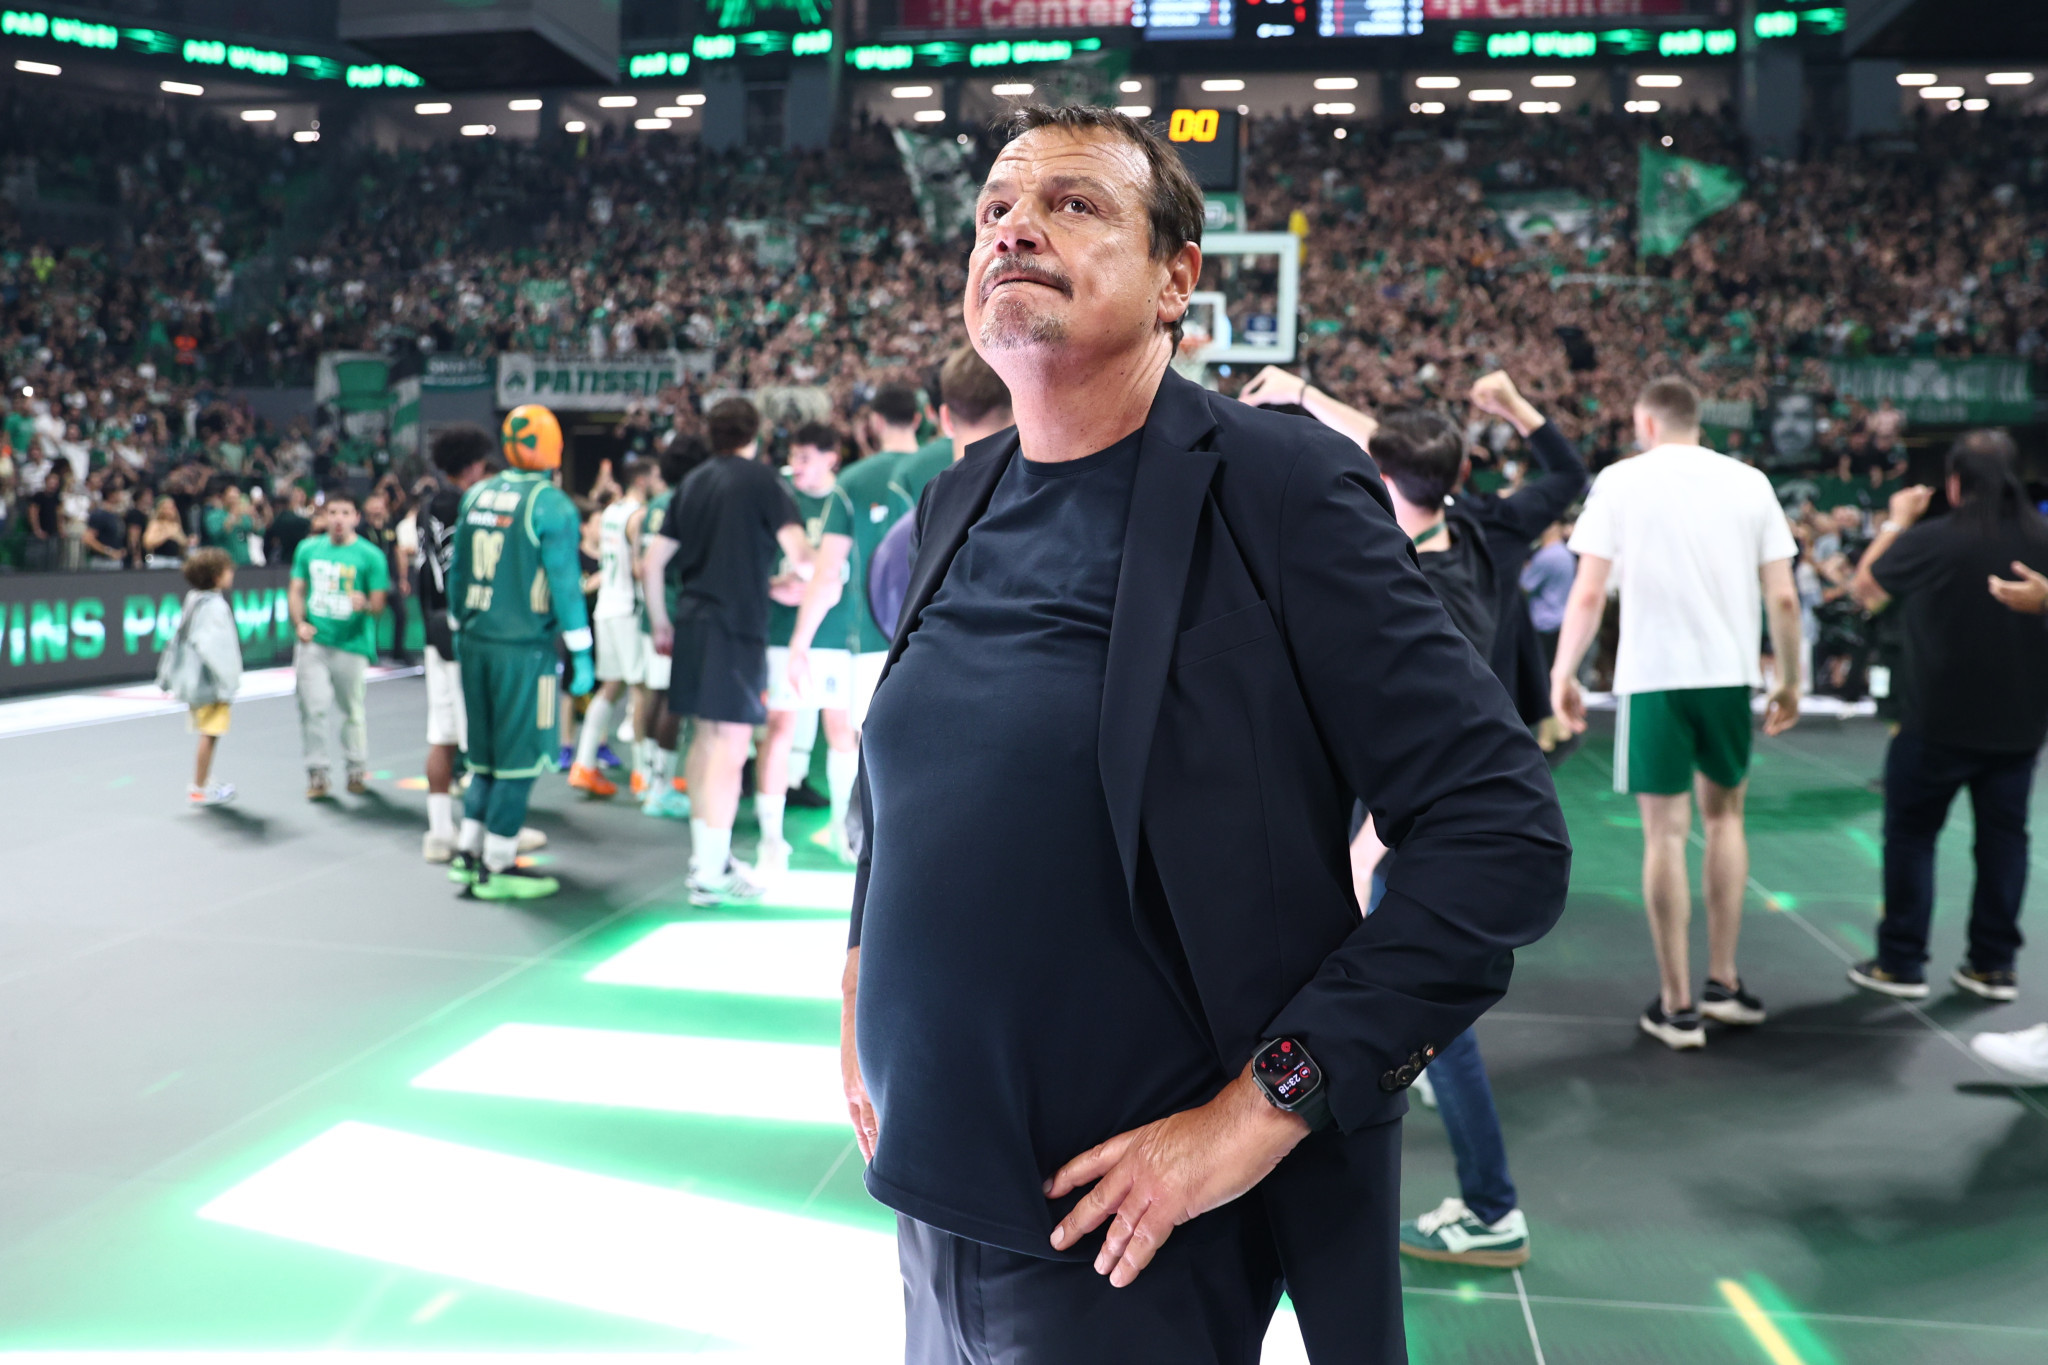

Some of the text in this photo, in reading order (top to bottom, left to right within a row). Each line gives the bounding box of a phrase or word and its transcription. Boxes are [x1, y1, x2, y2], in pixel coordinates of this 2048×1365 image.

[1168, 109, 1219, 142] 00
[0, 596, 106, 667] INS
[1278, 1074, 1300, 1094] 23:18
